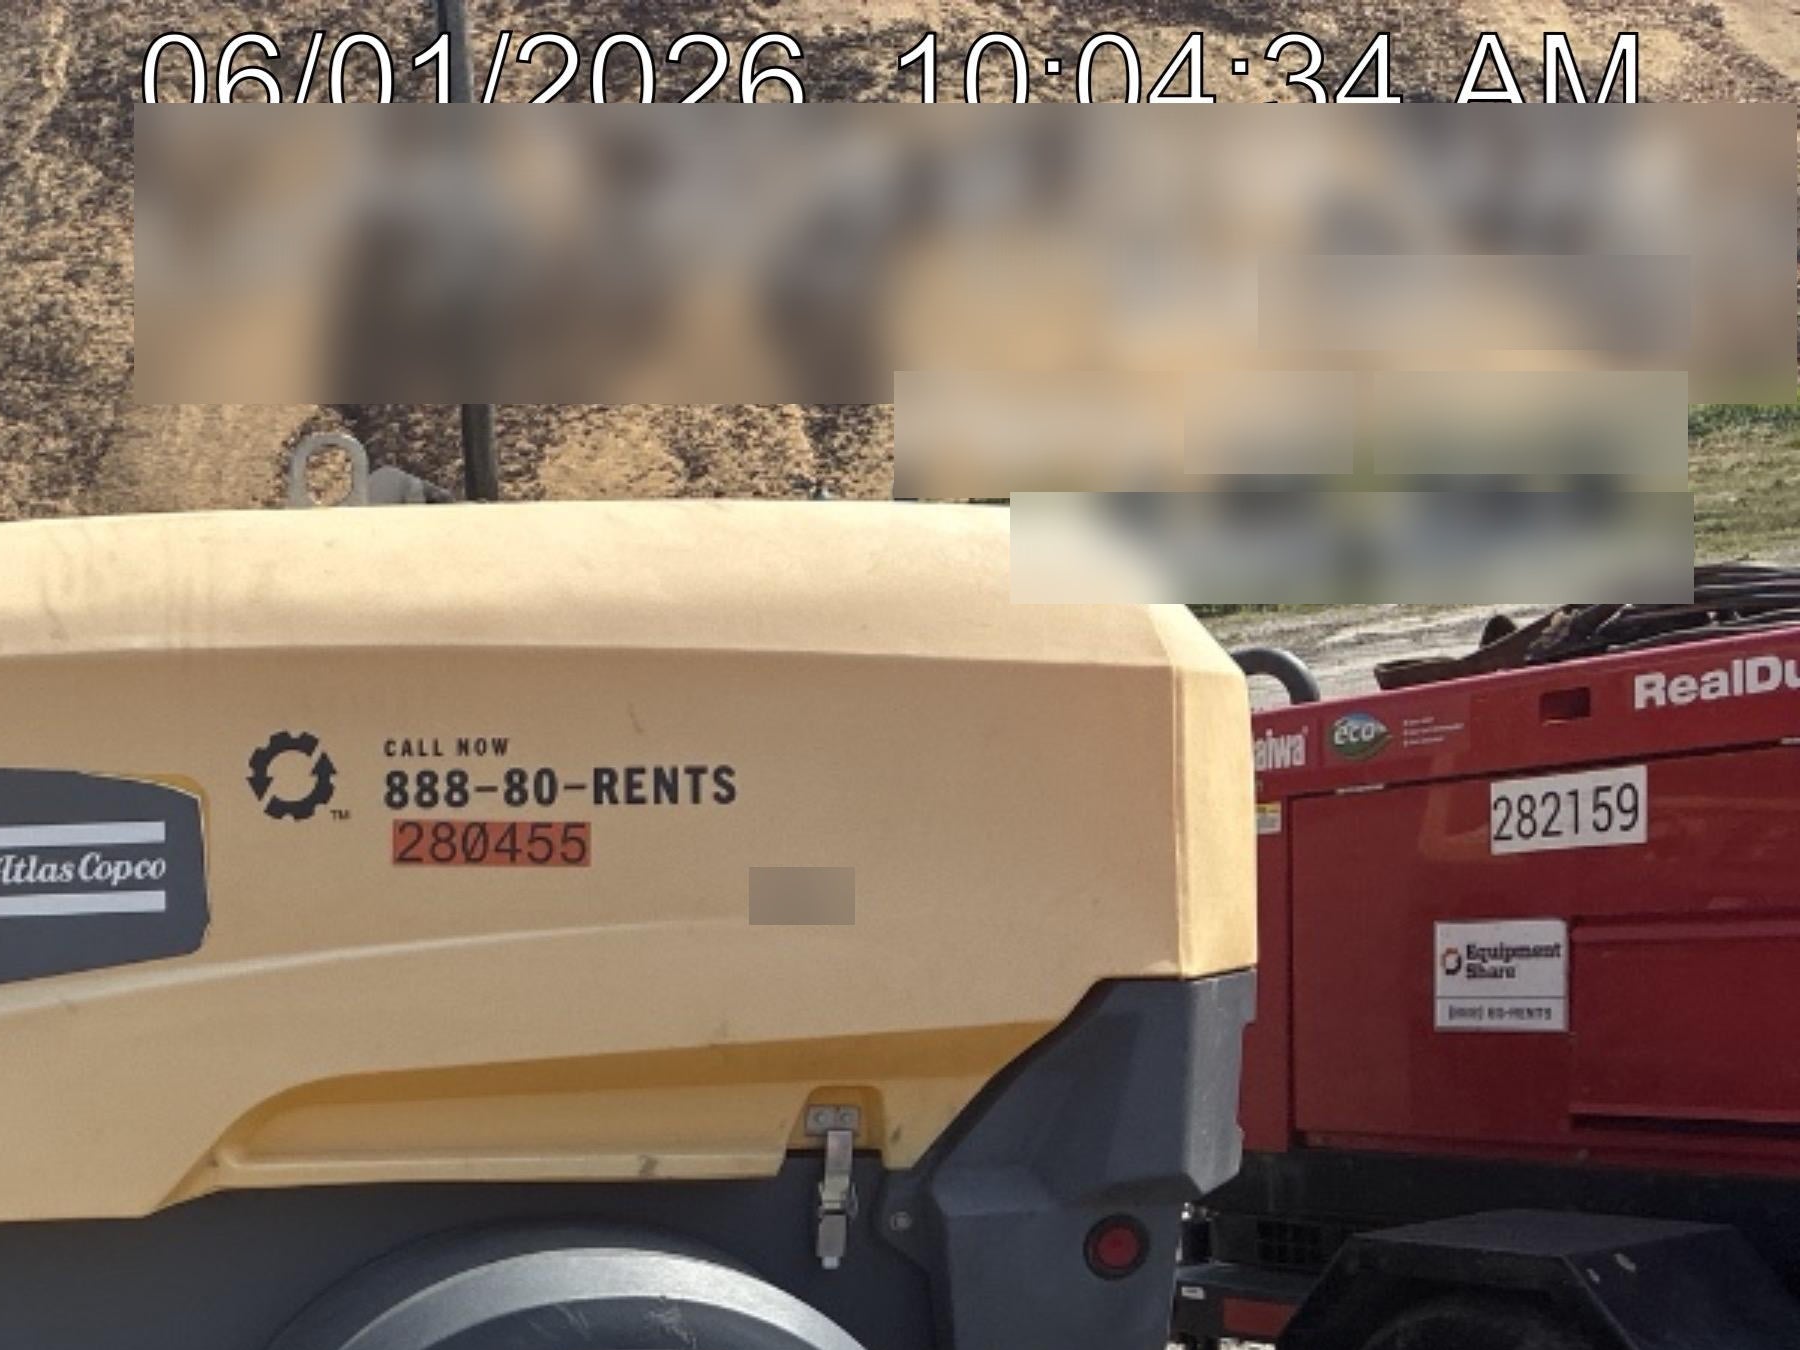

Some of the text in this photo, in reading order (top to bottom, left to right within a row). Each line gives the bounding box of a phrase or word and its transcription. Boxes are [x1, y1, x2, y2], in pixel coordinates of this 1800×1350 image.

[383, 738, 509, 757] CALL NOW
[1254, 727, 1307, 772] aiwa
[383, 765, 737, 810] 888-80-RENTS
[1493, 782, 1639, 842] 282159
[395, 821, 588, 864] 280455
[77, 851, 167, 887] Copco
